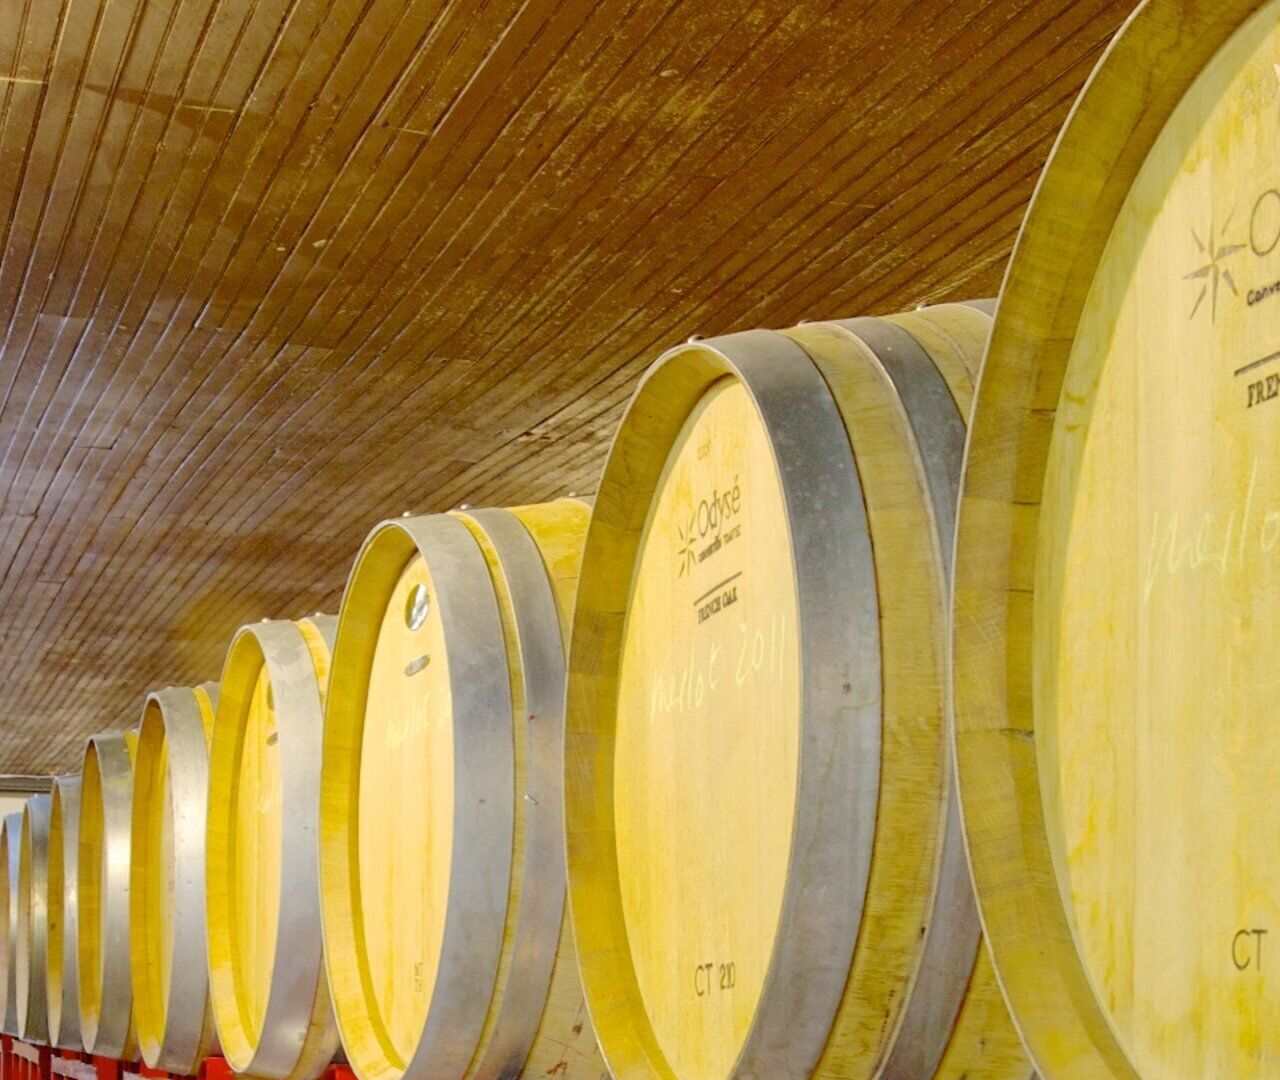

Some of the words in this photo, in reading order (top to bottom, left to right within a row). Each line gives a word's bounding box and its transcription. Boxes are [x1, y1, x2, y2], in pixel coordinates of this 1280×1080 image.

[735, 614, 786, 687] 2011
[1231, 928, 1269, 971] CT
[694, 962, 713, 997] CT
